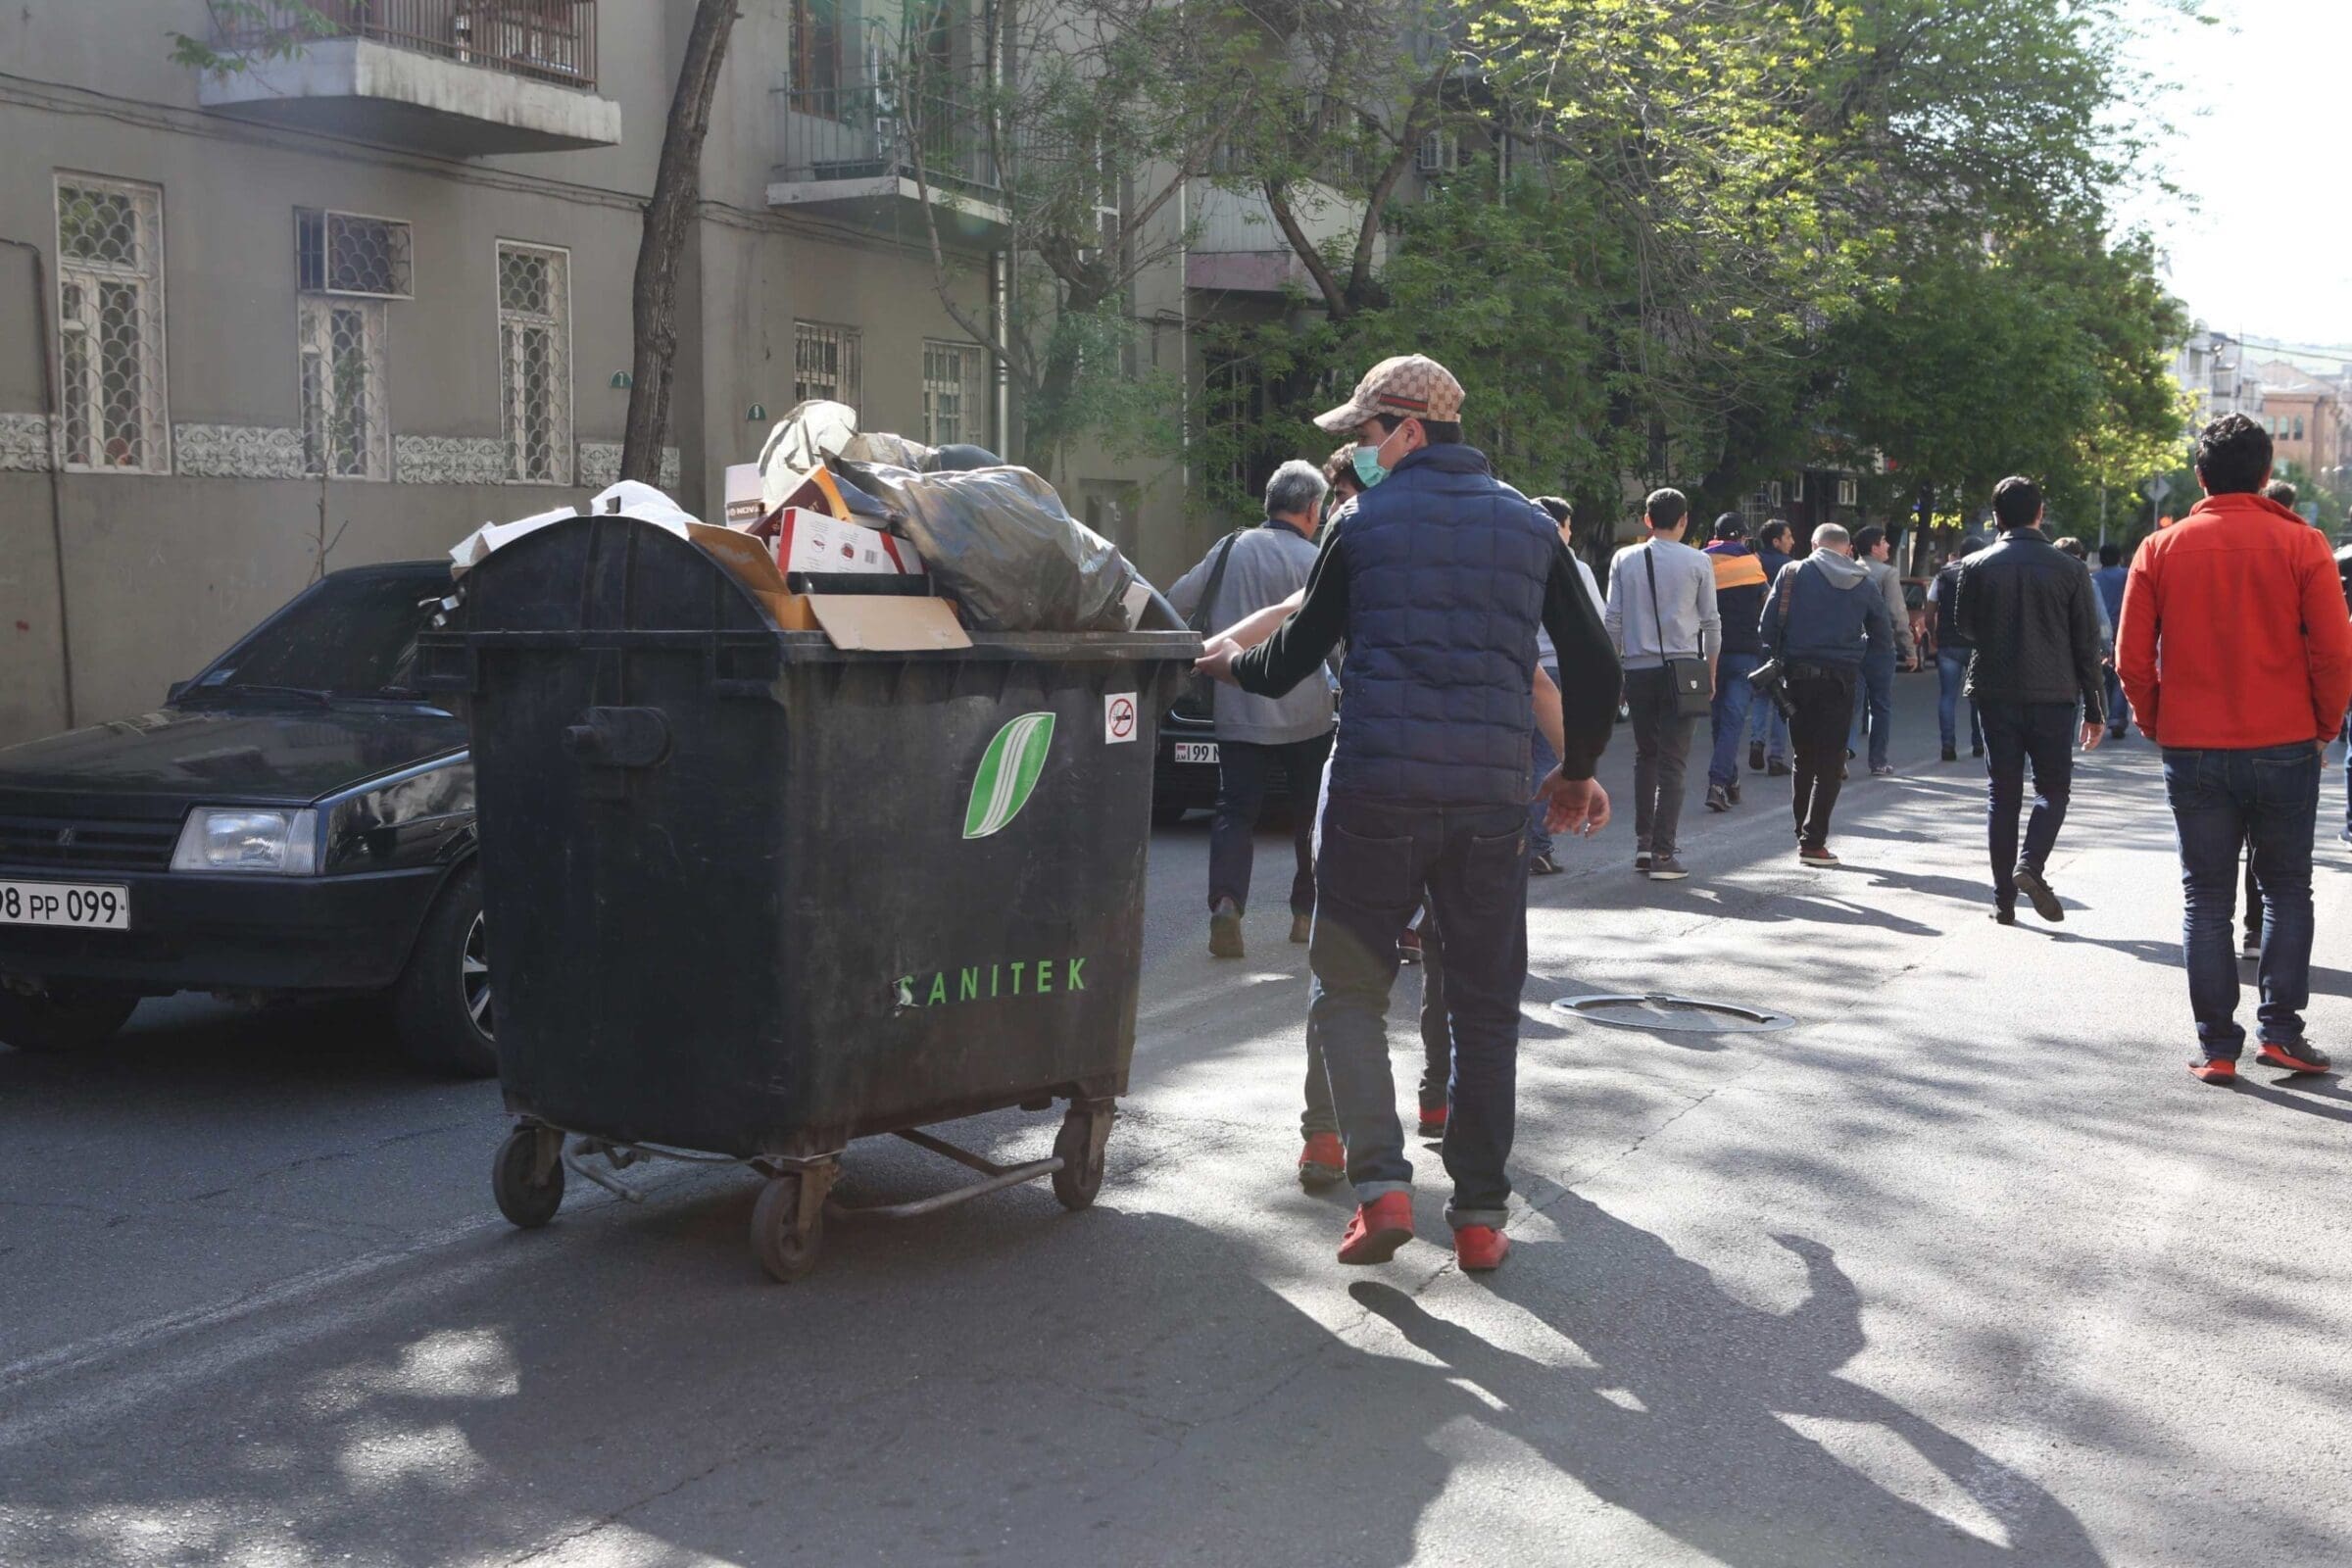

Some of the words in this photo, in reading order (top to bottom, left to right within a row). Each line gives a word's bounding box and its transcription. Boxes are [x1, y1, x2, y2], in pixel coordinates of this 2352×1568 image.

[0, 887, 21, 918] 8
[29, 895, 59, 920] PP
[67, 889, 117, 923] 099
[893, 957, 1086, 1006] SANITEK
